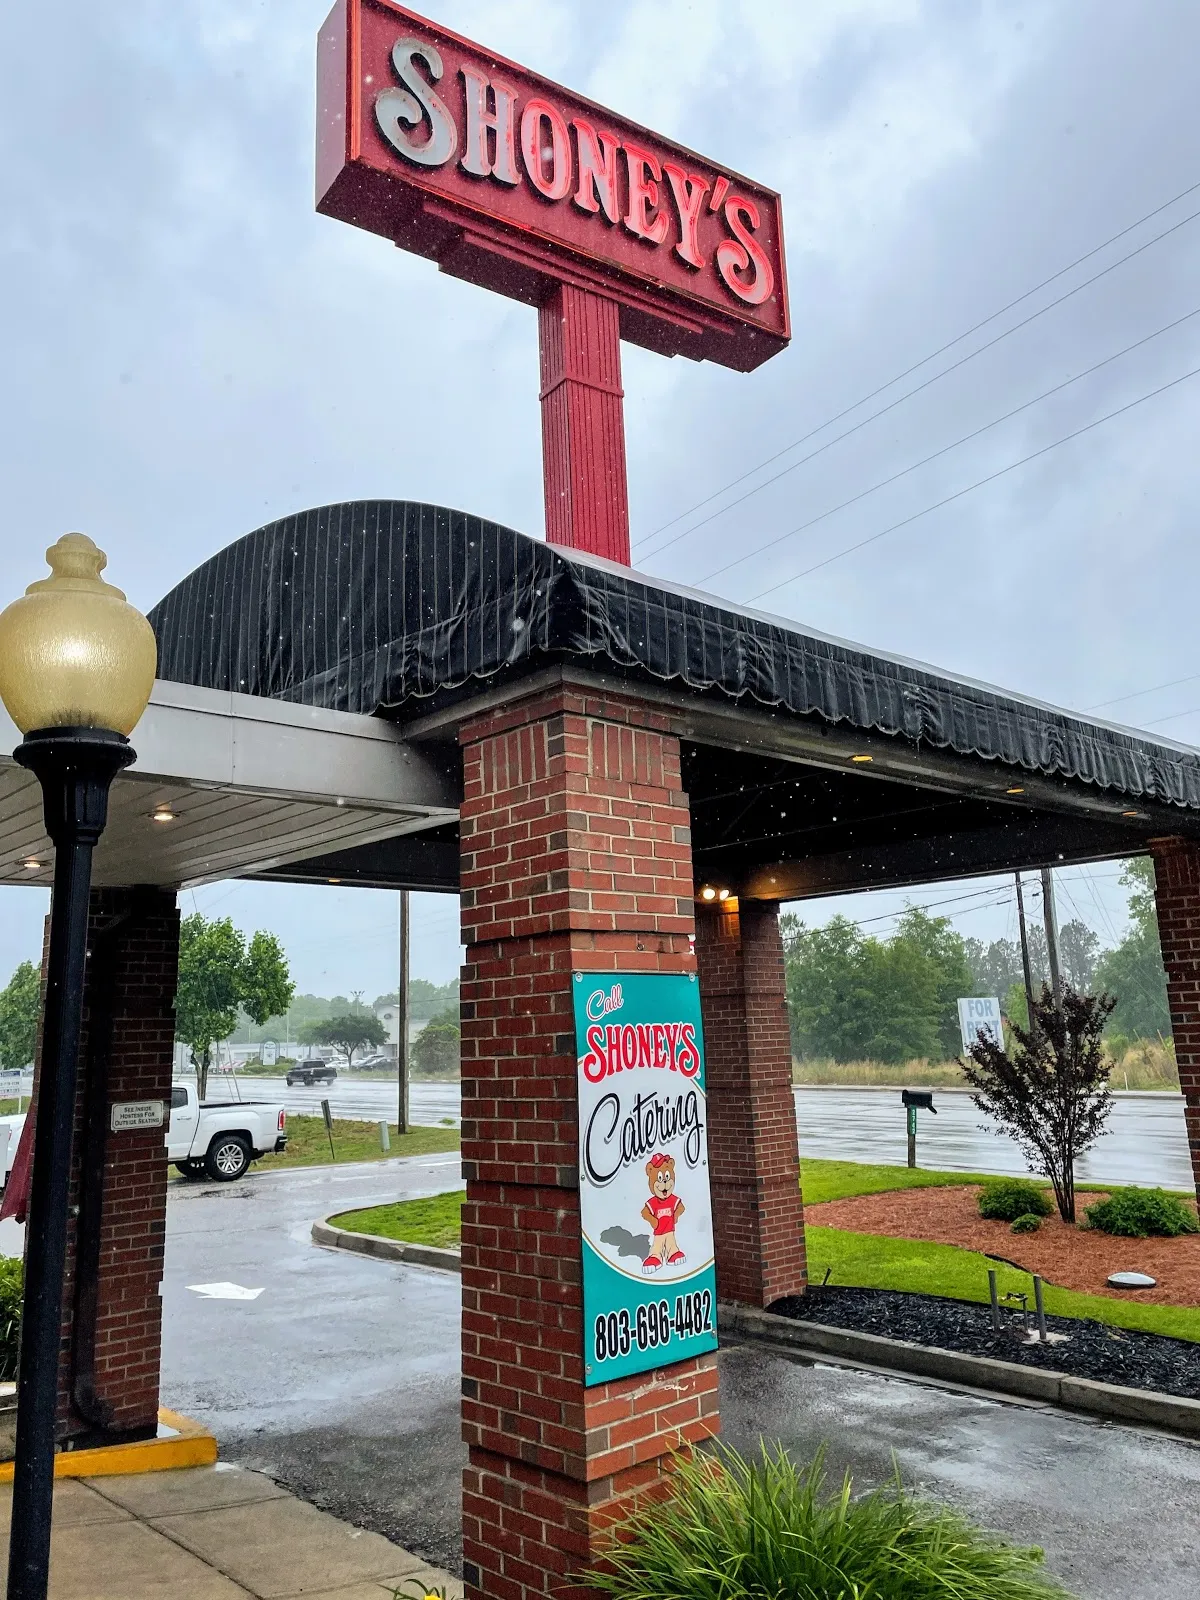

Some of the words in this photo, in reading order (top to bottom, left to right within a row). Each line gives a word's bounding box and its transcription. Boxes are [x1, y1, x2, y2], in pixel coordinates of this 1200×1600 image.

[375, 37, 774, 304] SHONEY'S
[587, 984, 624, 1021] Call
[968, 999, 994, 1017] FOR
[583, 1021, 700, 1083] SHONEY'S
[584, 1090, 704, 1187] Catering
[595, 1288, 712, 1362] 803-696-4482
